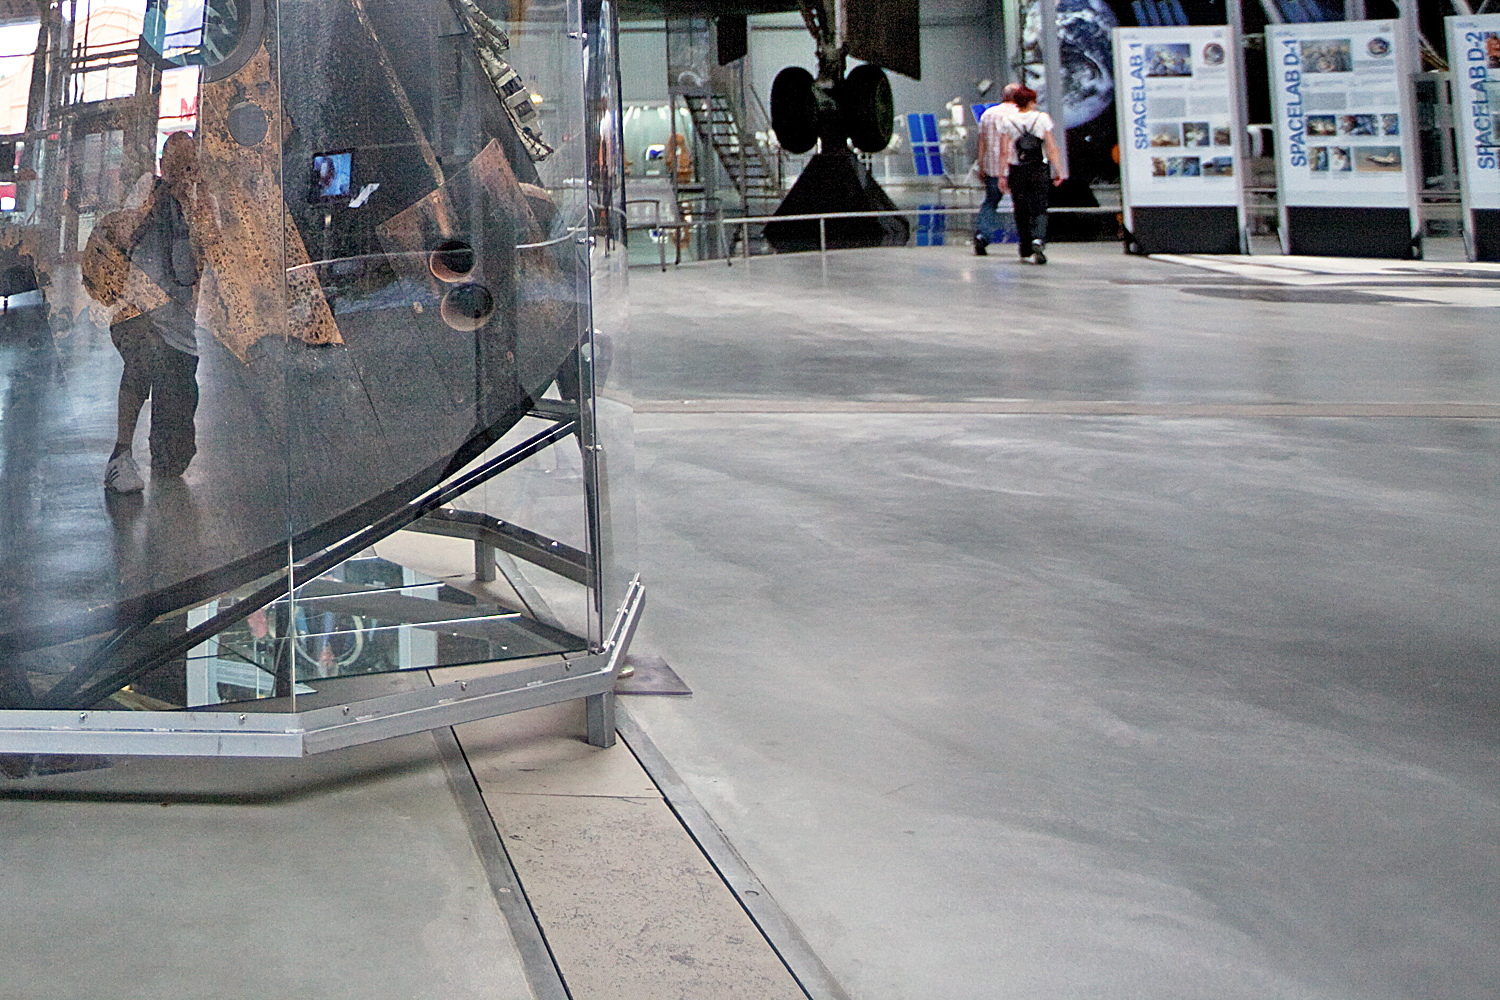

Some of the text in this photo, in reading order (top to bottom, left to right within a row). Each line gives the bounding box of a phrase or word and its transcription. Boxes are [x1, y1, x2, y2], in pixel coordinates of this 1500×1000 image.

[1281, 39, 1299, 67] D-1
[1465, 30, 1485, 62] D-2
[1130, 54, 1149, 150] SPACELAB
[1284, 70, 1307, 167] SPACELAB
[1468, 64, 1496, 169] SPACELAB
